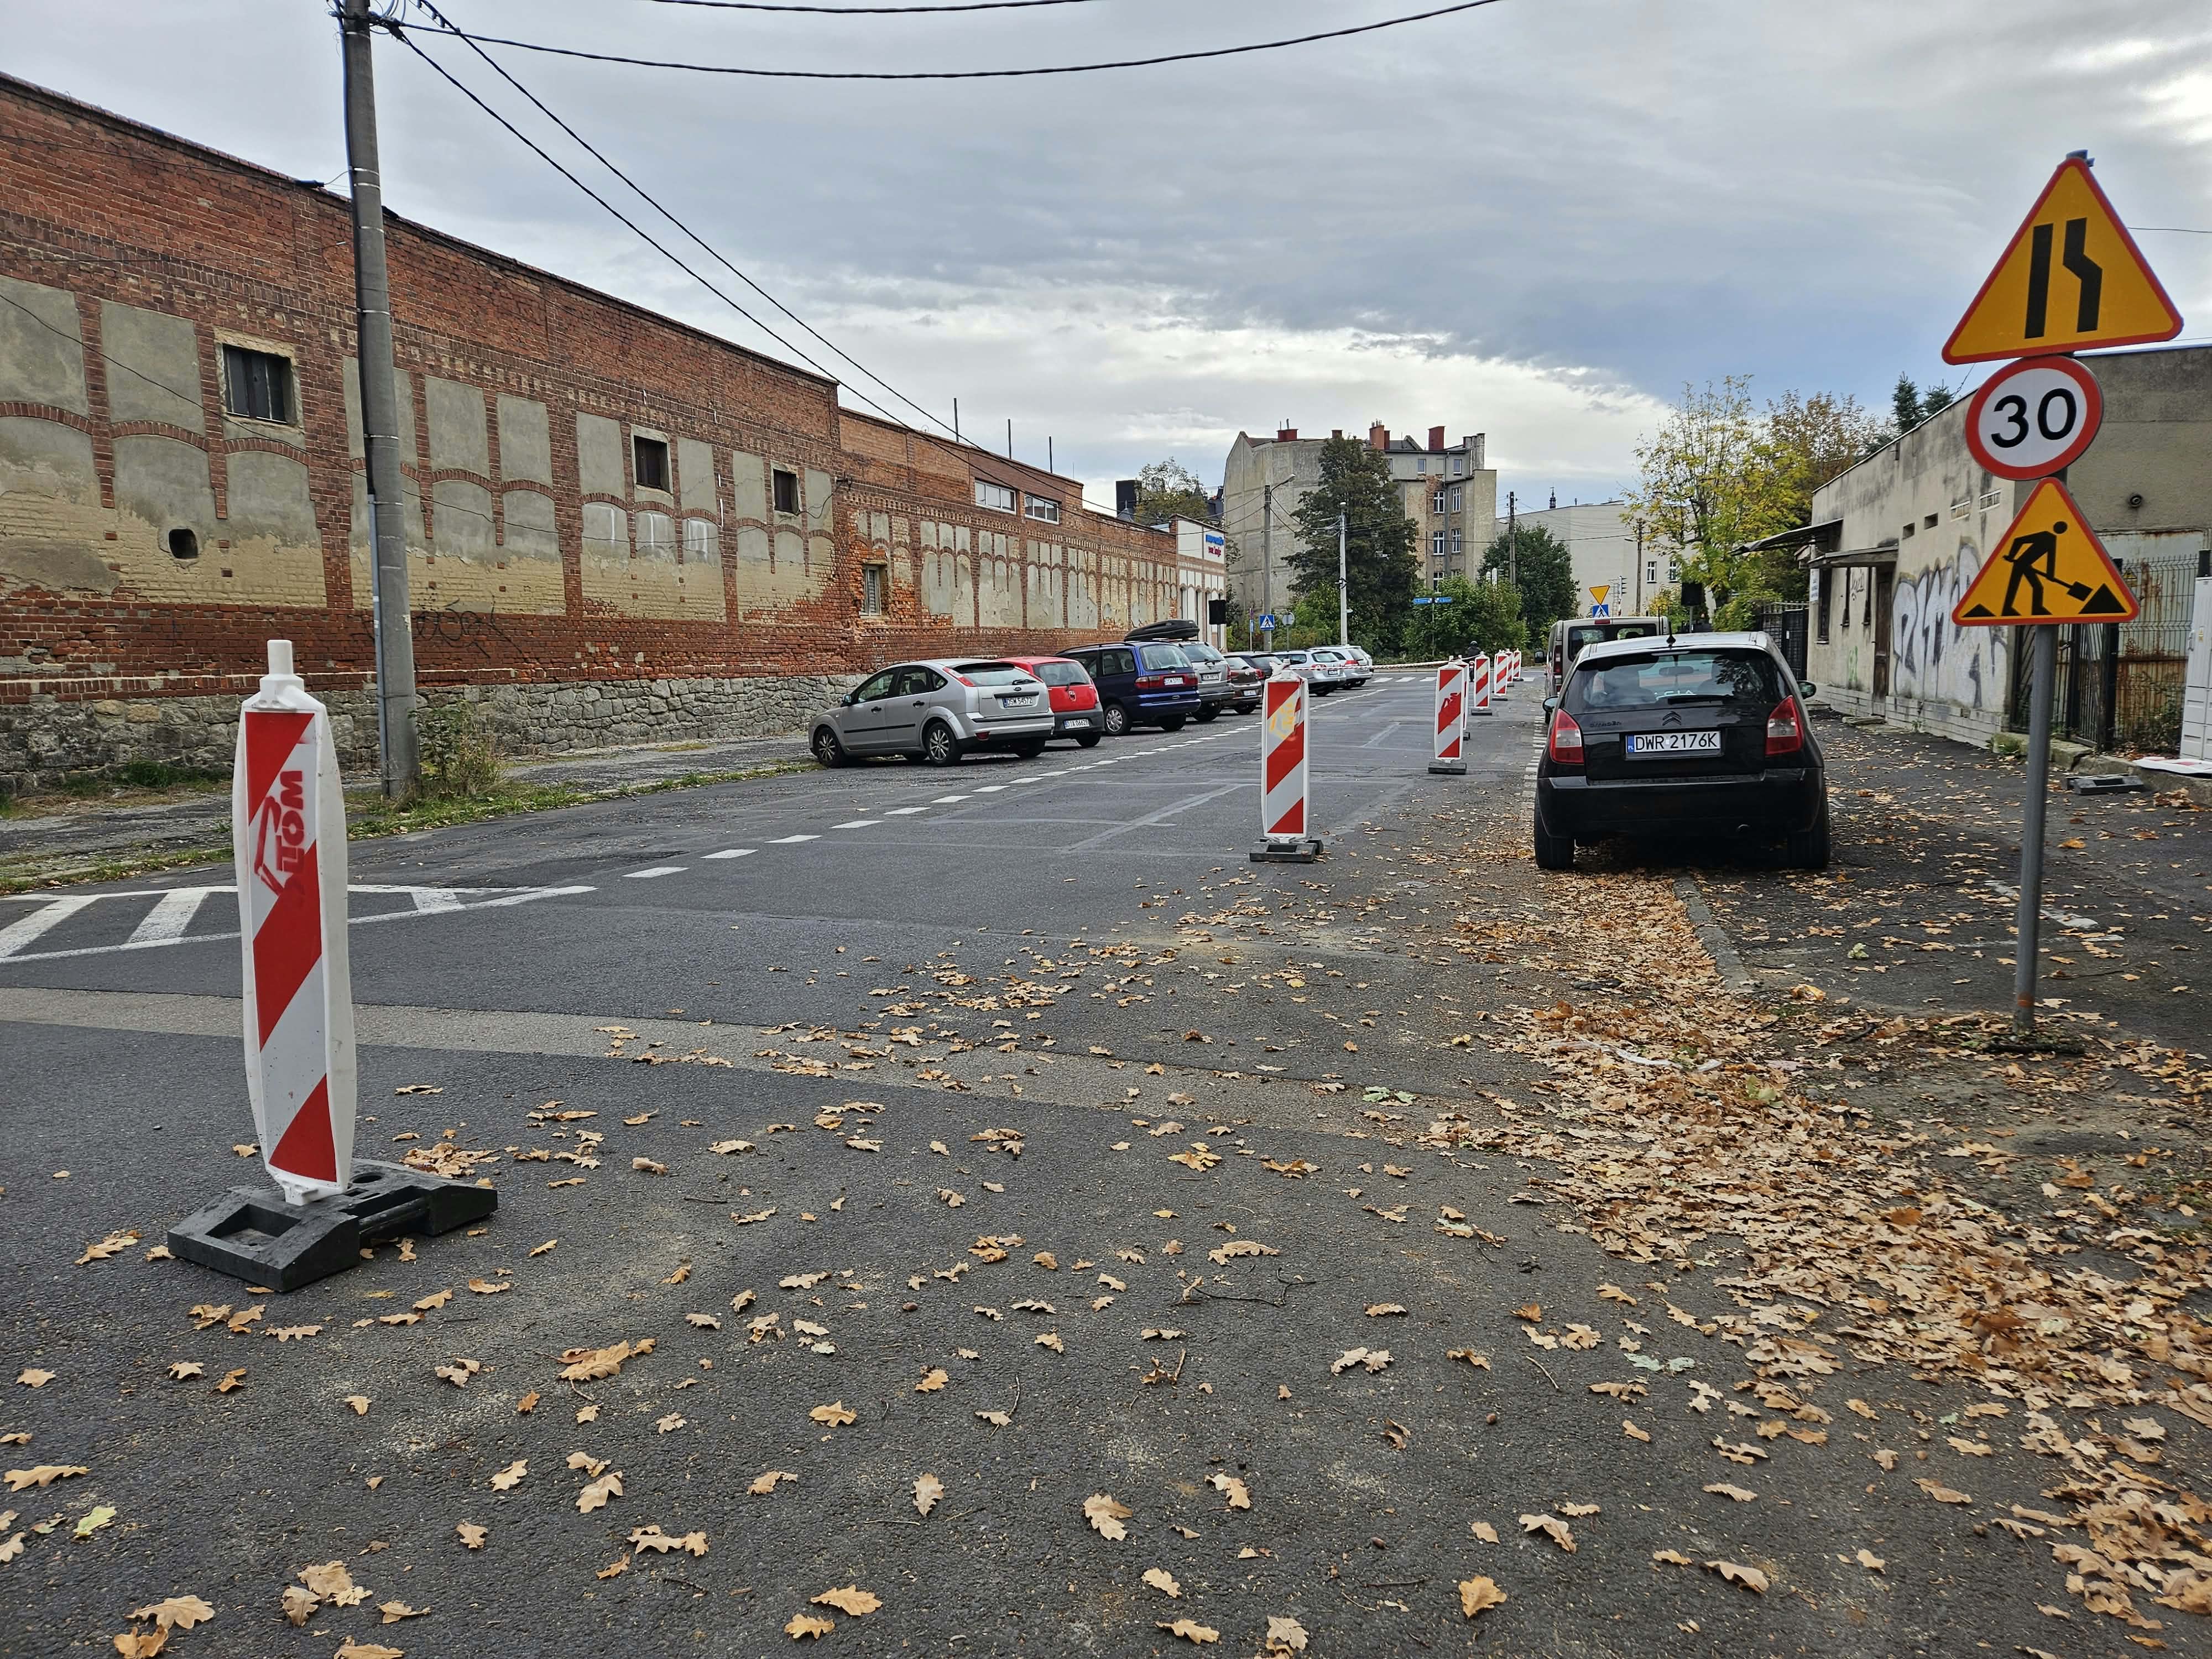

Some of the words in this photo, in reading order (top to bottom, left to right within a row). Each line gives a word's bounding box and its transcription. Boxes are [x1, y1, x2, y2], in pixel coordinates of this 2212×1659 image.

[1991, 388, 2077, 448] 30
[1635, 735, 1665, 750] DWR
[1670, 733, 1717, 748] 2176K
